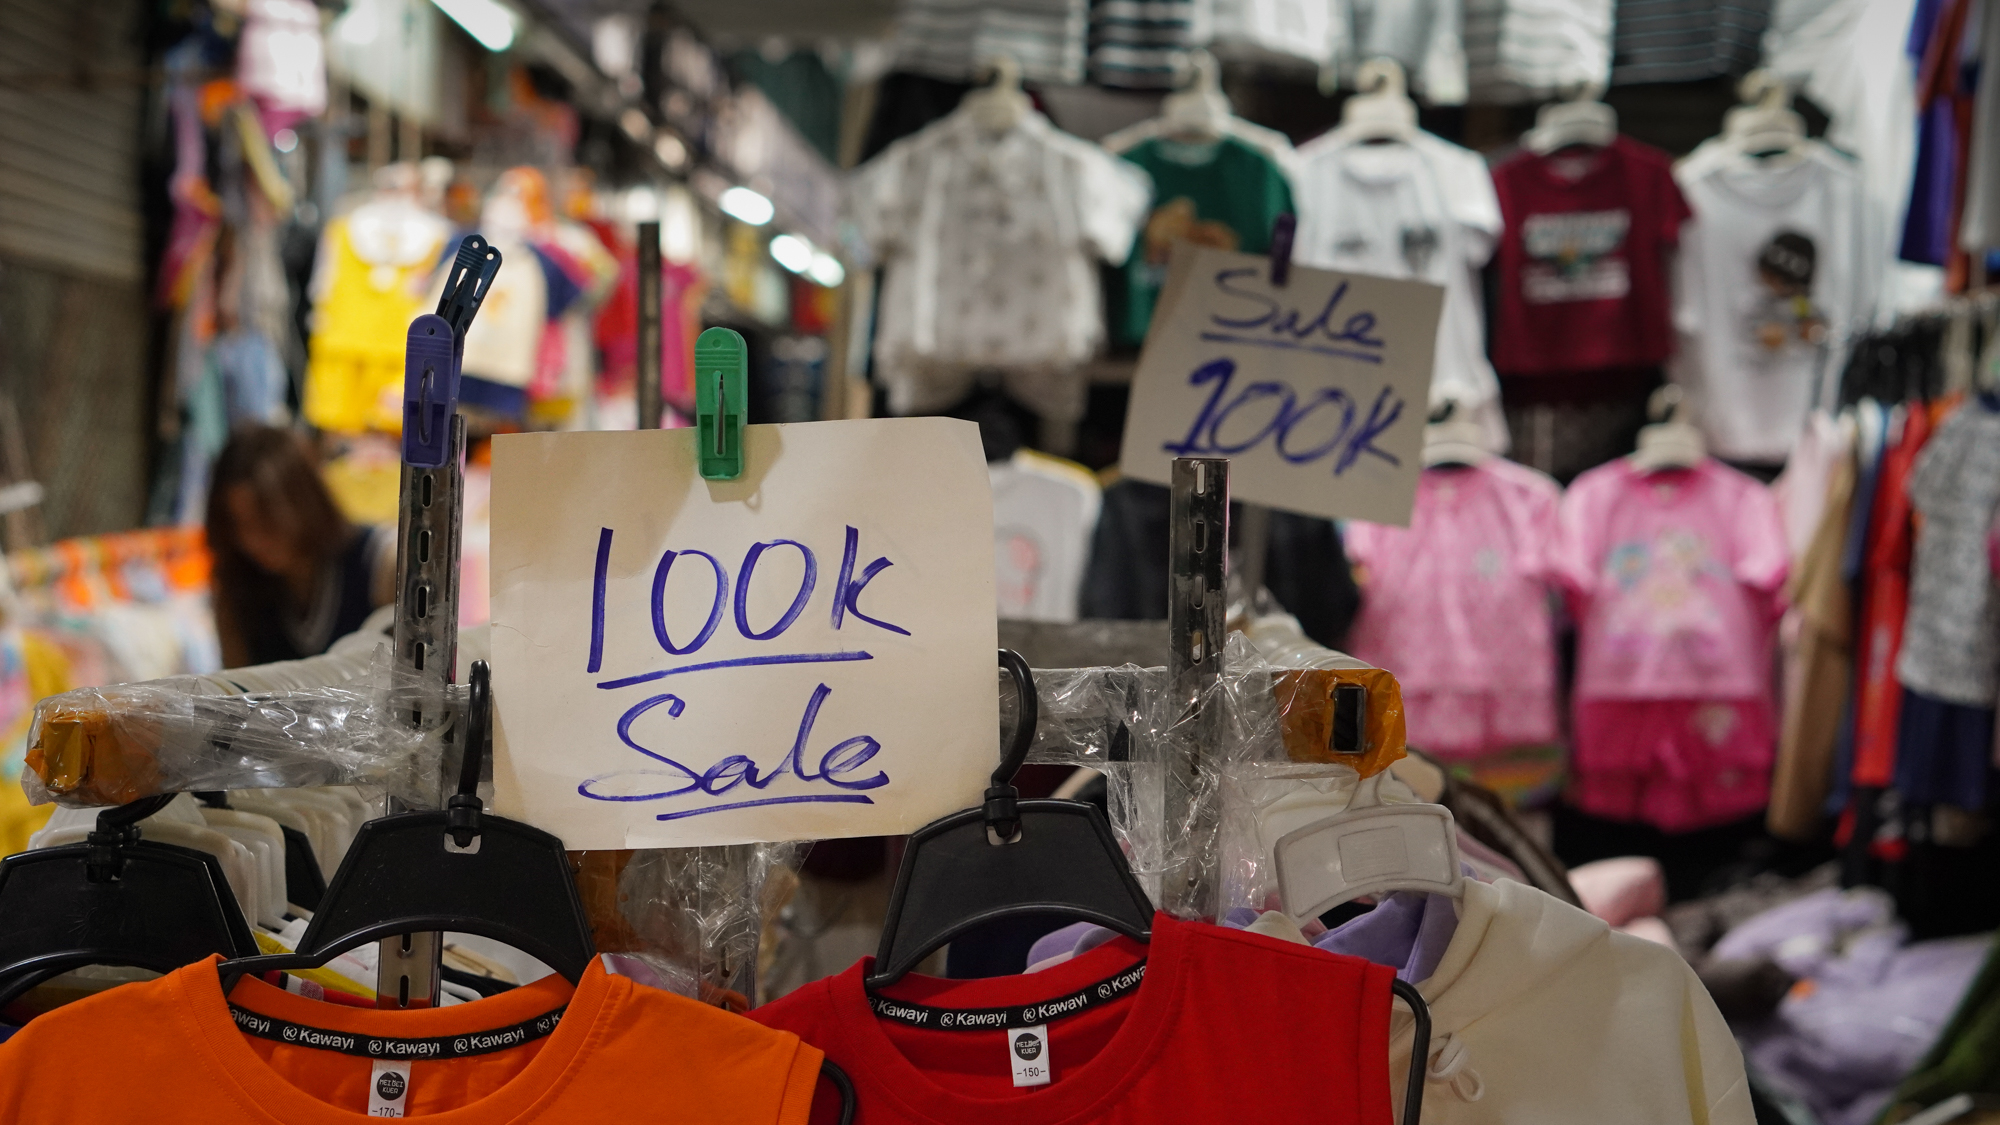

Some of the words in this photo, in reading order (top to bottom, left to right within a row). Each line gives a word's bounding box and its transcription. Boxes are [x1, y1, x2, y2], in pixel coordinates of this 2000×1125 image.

[1211, 268, 1386, 348] Sale
[577, 682, 890, 802] Sale
[227, 1004, 271, 1034] awayi
[299, 1027, 355, 1050] Kawayi
[385, 1041, 440, 1056] Kawayi
[470, 1027, 526, 1050] Kawayi
[877, 1000, 929, 1025] Kawayi
[956, 1010, 1007, 1027] Kawayi
[1038, 992, 1088, 1019] Kawayi
